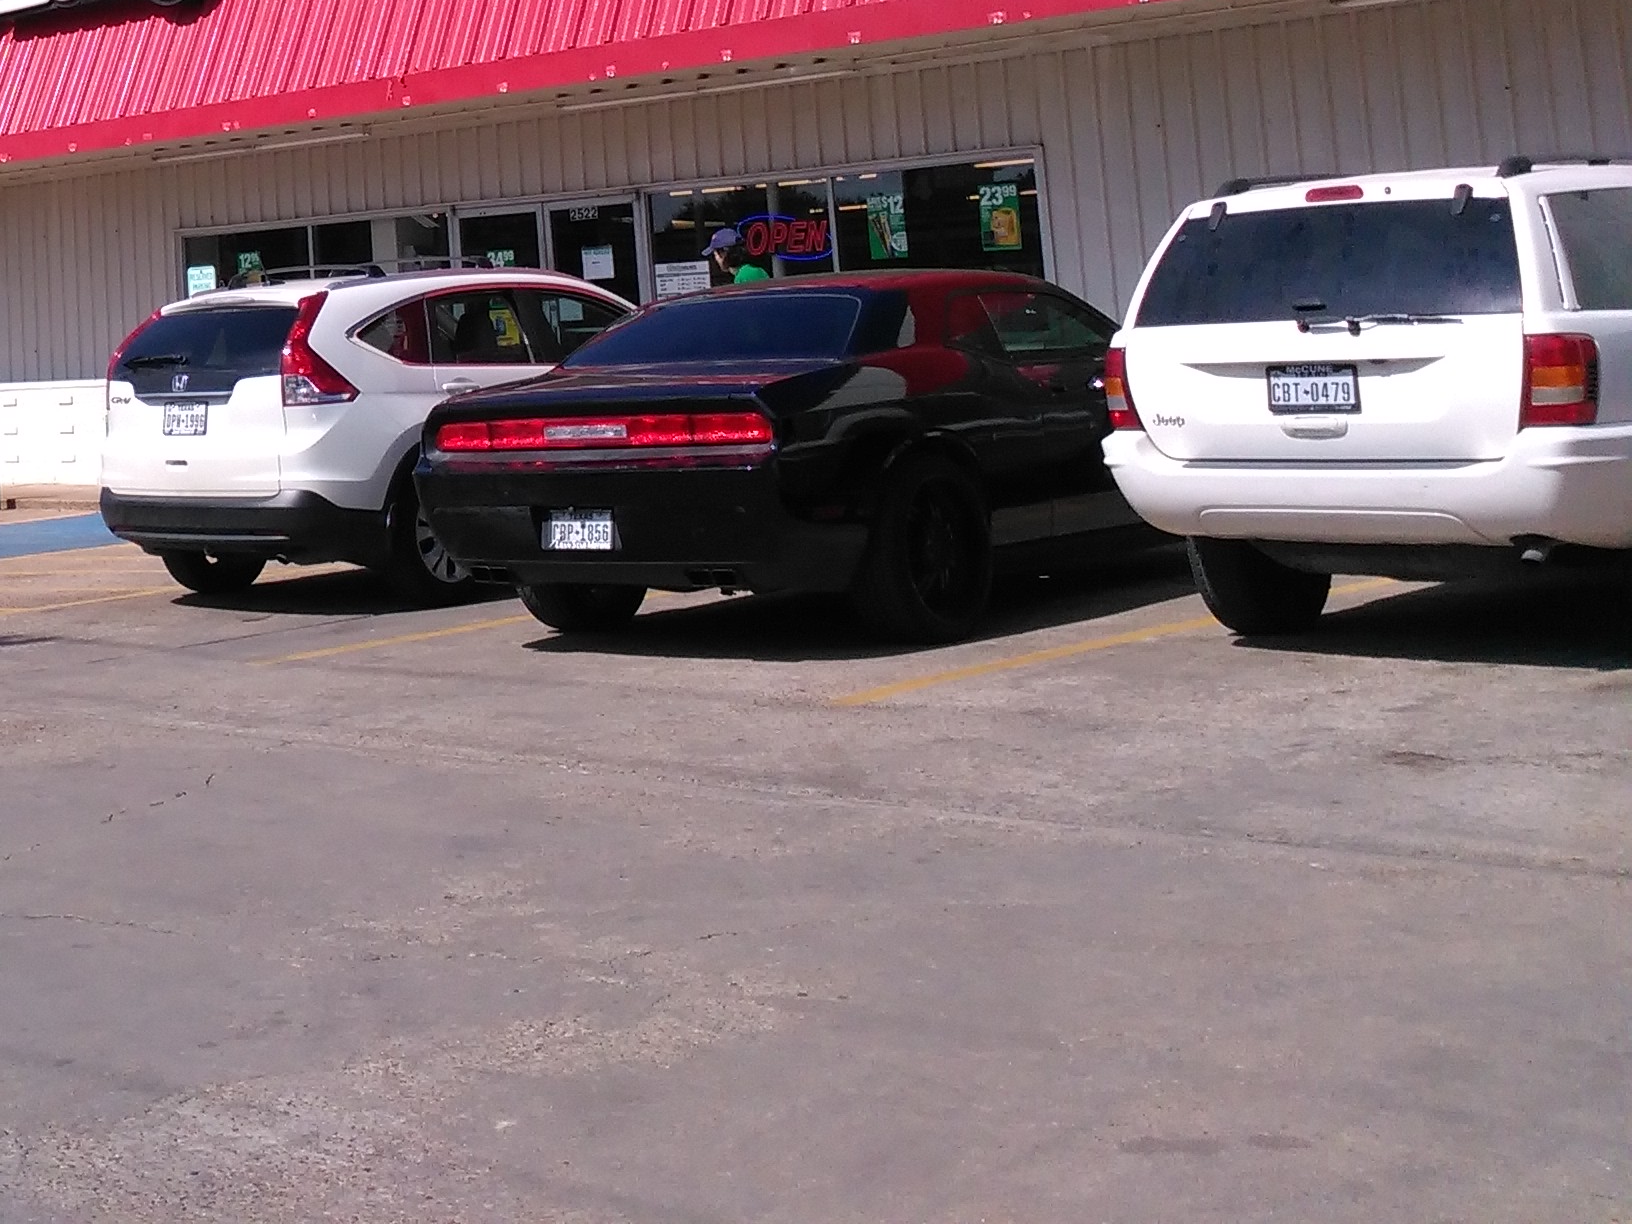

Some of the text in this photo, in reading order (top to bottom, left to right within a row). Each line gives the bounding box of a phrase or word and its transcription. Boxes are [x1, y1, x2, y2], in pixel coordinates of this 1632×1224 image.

[570, 207, 598, 221] 2522
[747, 220, 827, 255] OPEN
[1152, 414, 1185, 427] Jeep
